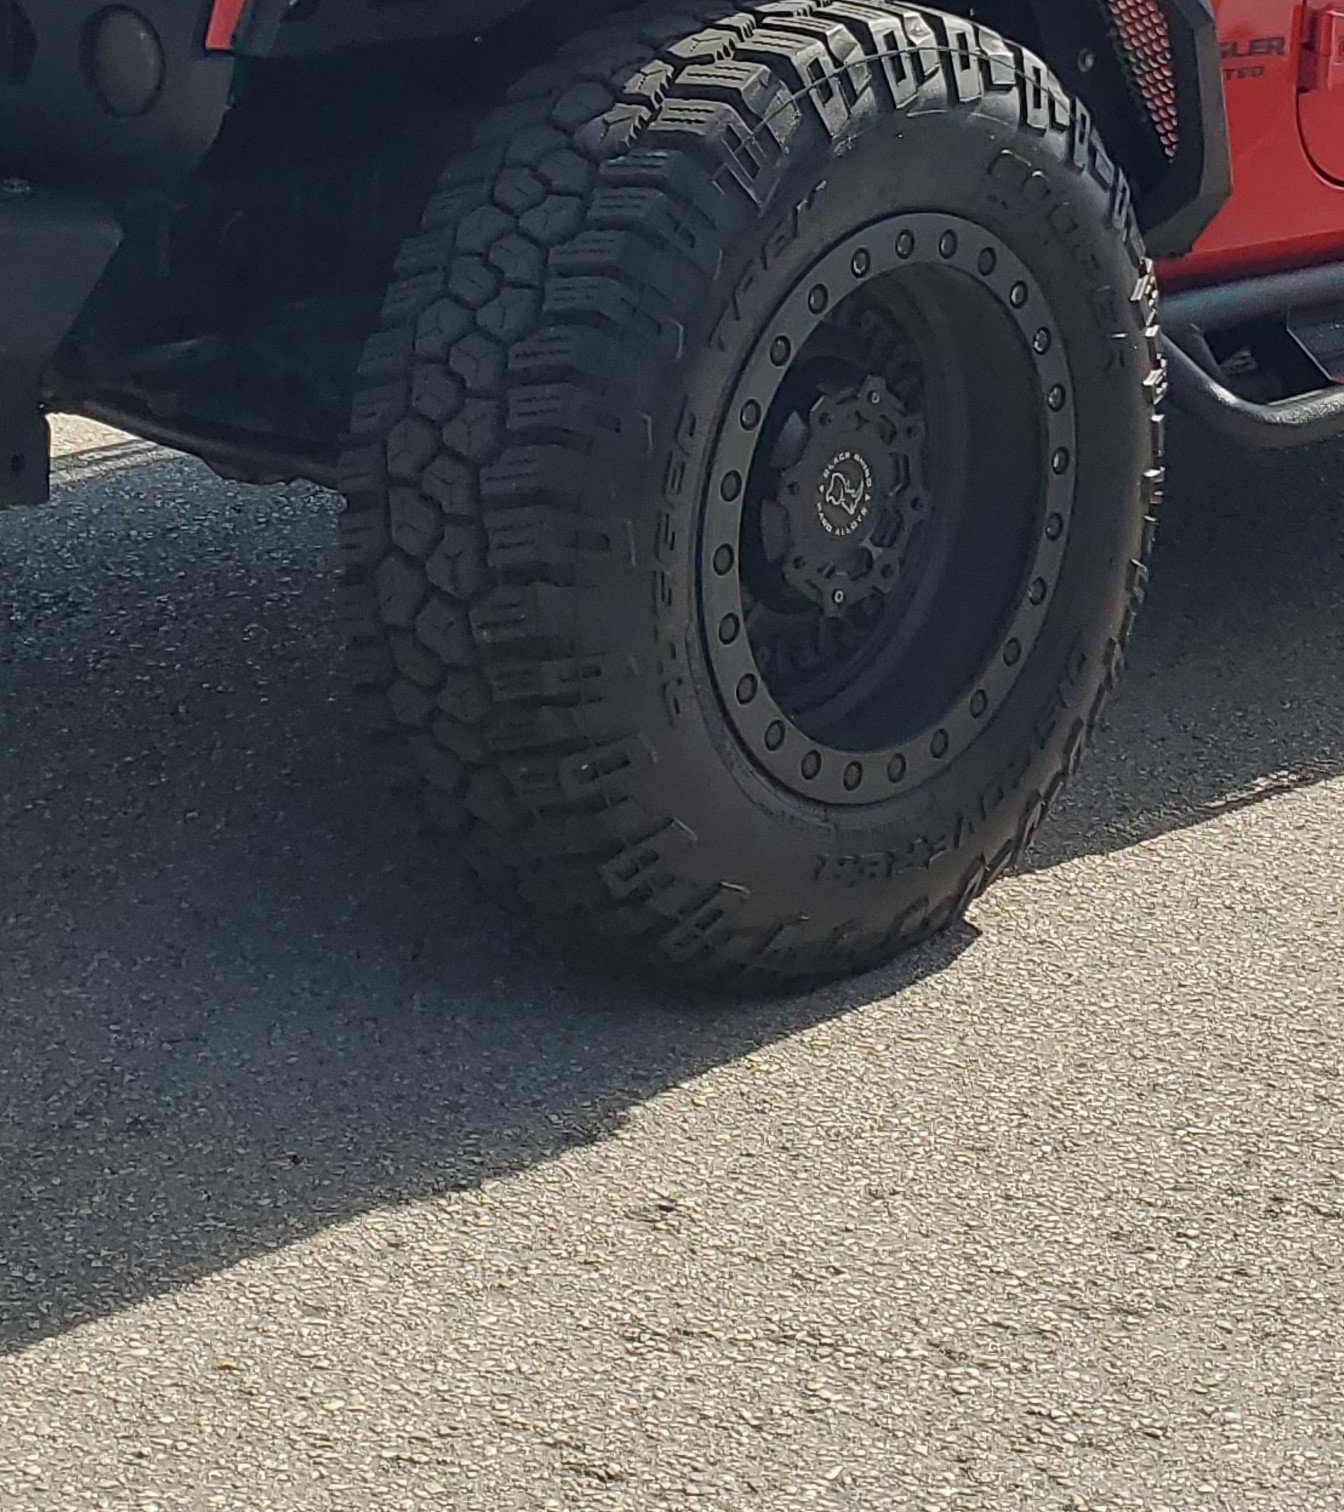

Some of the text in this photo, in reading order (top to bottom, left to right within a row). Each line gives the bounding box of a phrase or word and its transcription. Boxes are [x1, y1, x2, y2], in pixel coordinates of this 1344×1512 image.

[823, 451, 872, 487] BLACK RHINO
[816, 502, 868, 536] HARD ALLOYS
